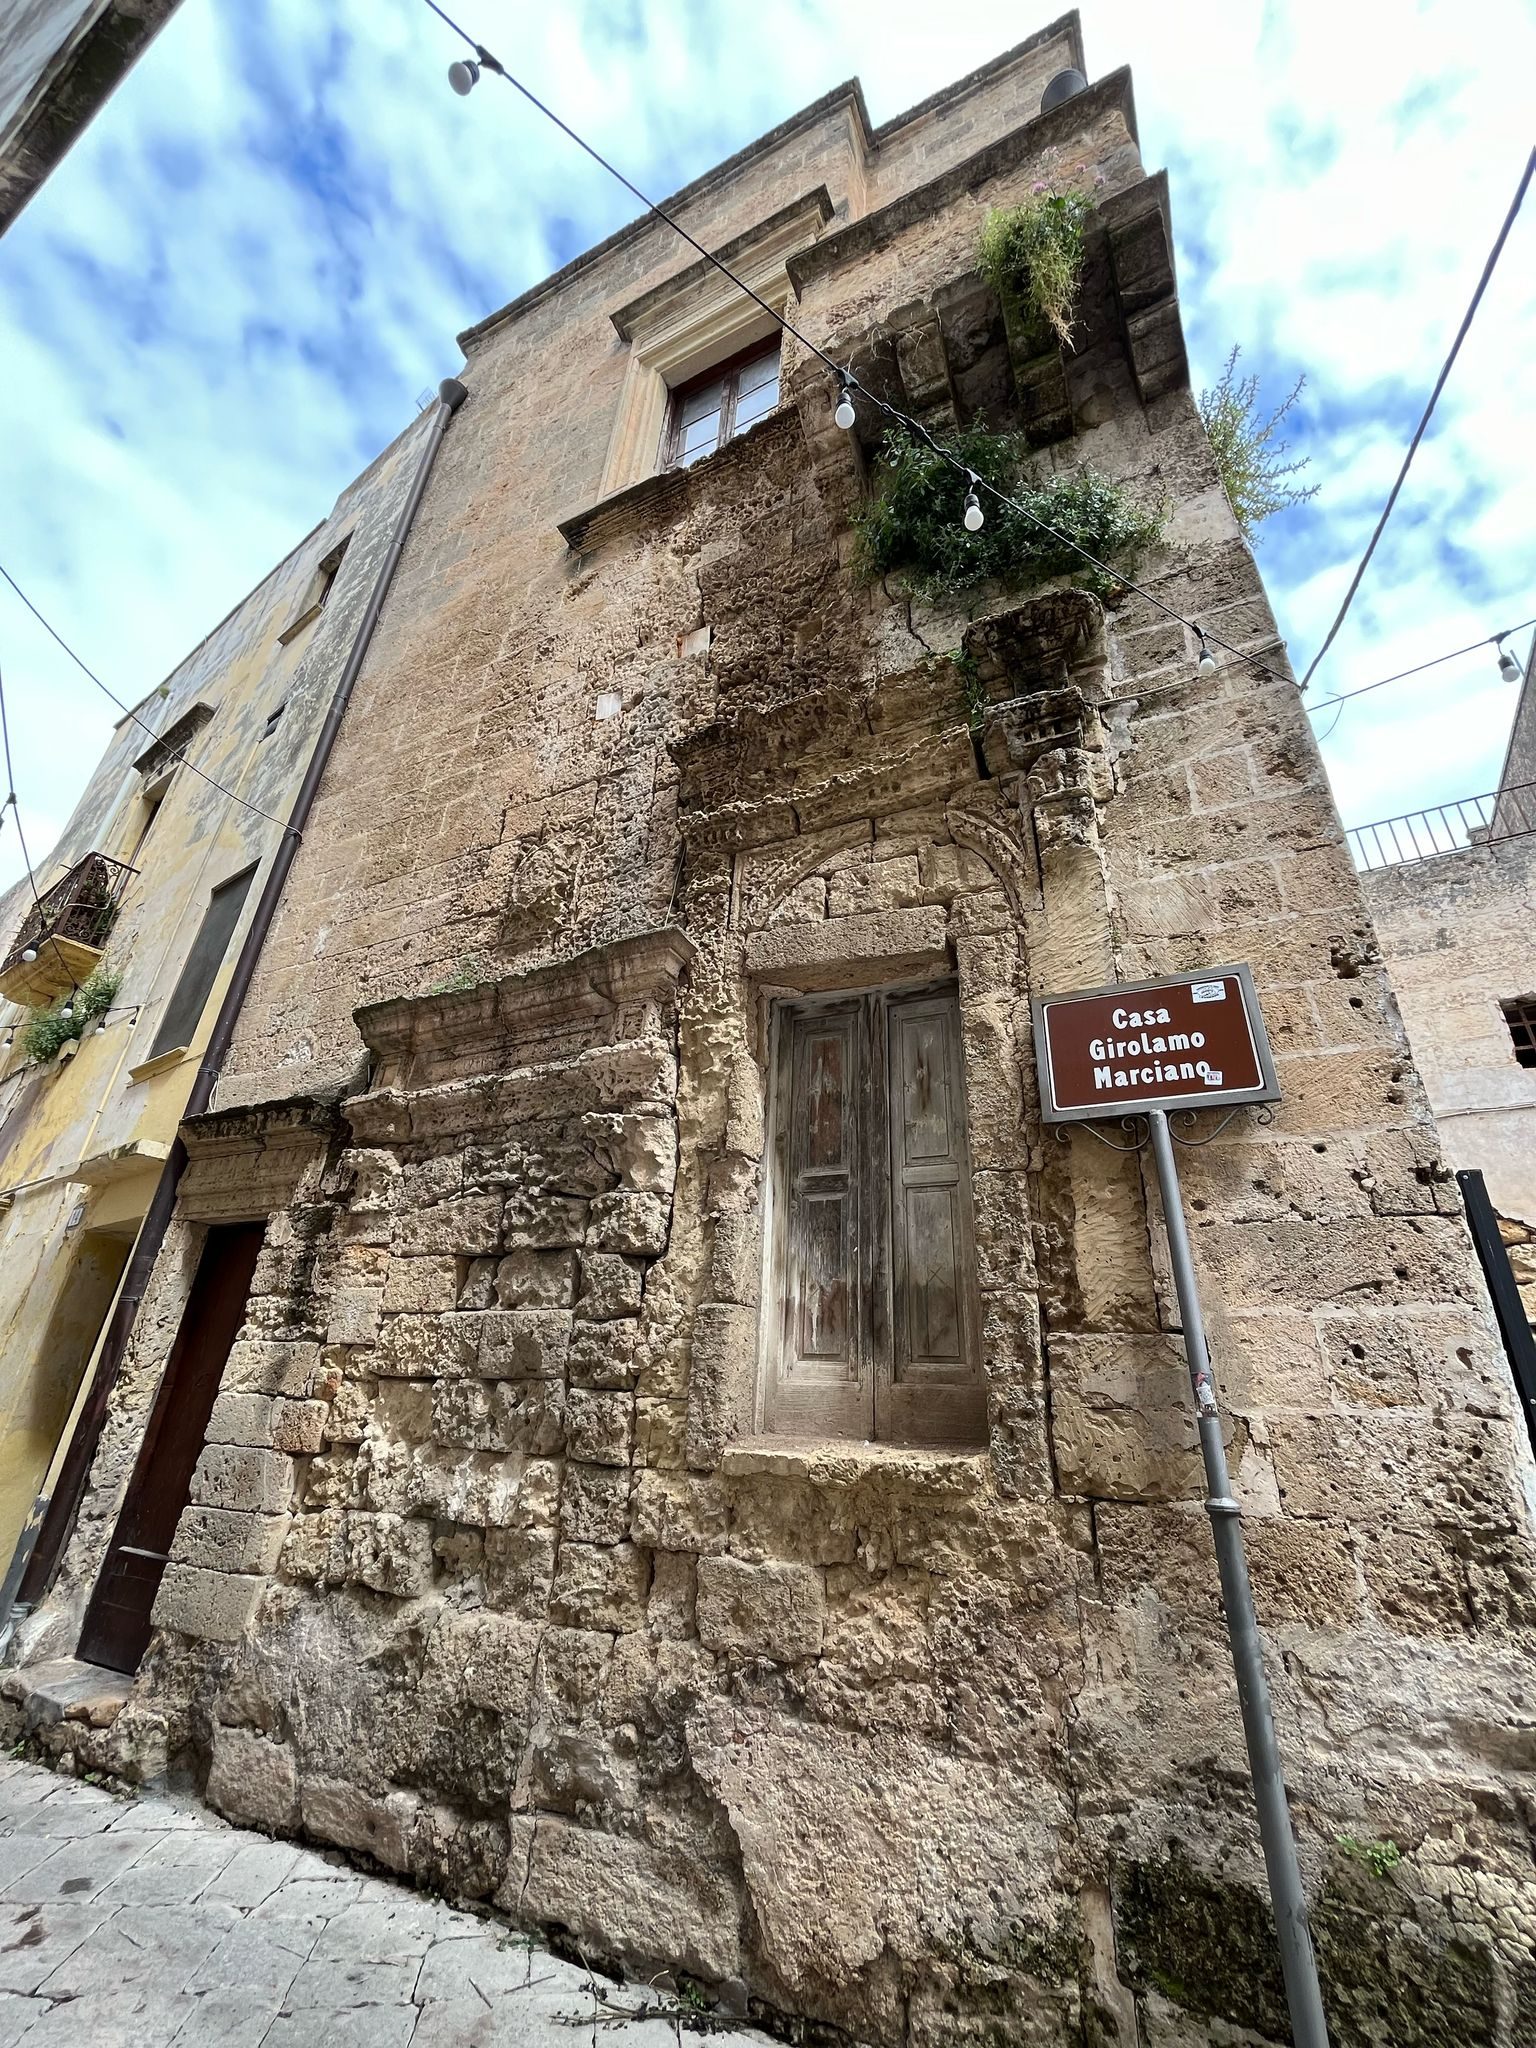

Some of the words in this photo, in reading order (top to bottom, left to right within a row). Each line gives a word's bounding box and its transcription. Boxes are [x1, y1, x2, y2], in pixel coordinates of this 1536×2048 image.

[1112, 1008, 1171, 1030] Casa
[1089, 1031, 1206, 1061] Girolamo
[1093, 1060, 1210, 1090] Marciano
